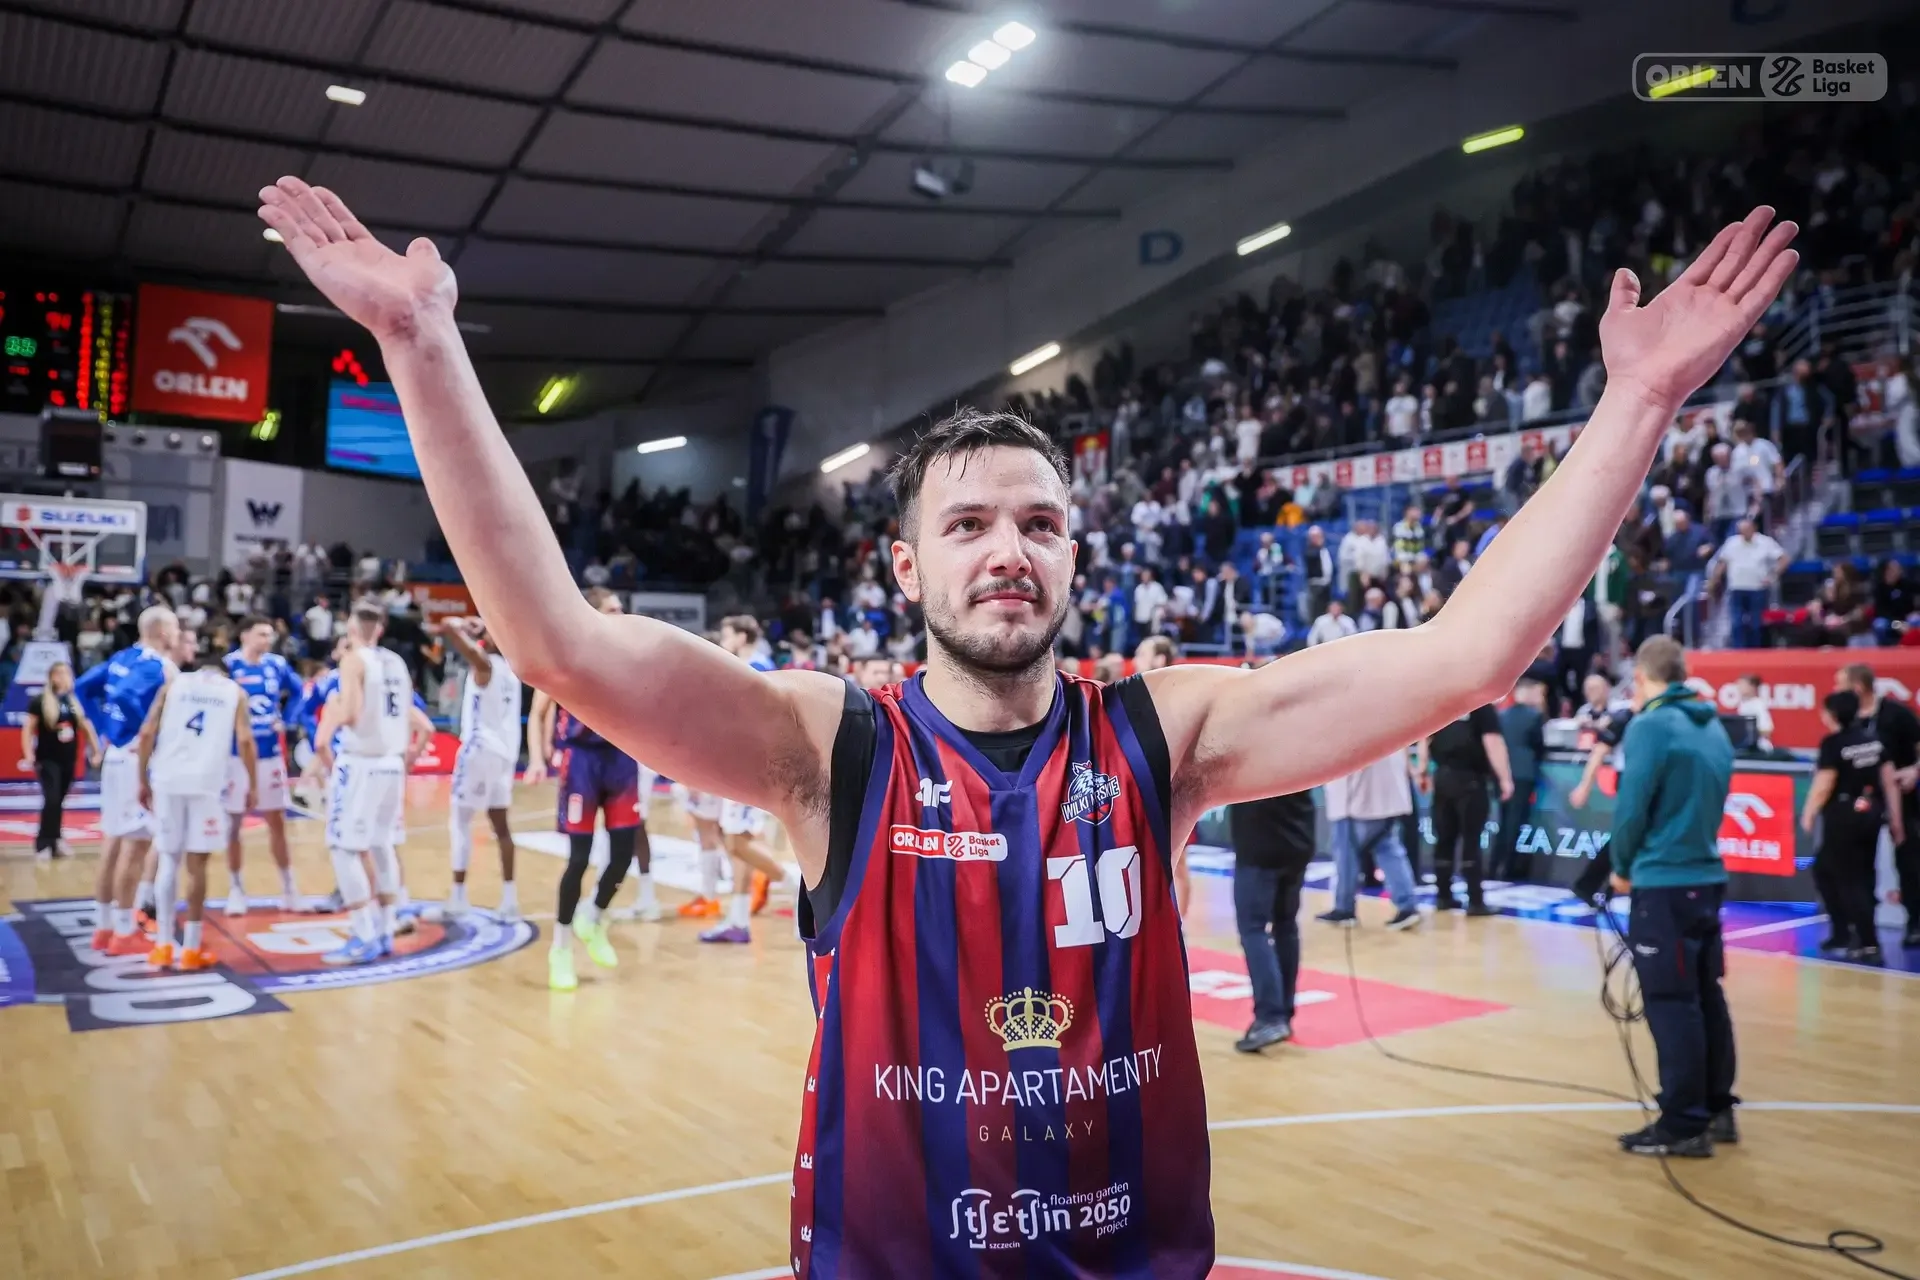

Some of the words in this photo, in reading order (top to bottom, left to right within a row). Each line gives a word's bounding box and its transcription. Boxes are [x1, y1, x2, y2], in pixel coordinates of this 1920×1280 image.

[154, 370, 248, 402] ORLEN
[41, 511, 127, 526] SUZUKI
[1718, 682, 1816, 710] OLEN
[185, 709, 206, 737] 4
[1063, 795, 1089, 820] WILKI
[1090, 778, 1119, 807] RSKIE
[893, 832, 939, 851] ORLEN
[968, 835, 1001, 847] Basket
[969, 846, 989, 857] Liga
[1516, 824, 1553, 856] ZA
[1716, 837, 1781, 860] RLEN
[1046, 845, 1142, 949] 10
[875, 1063, 945, 1104] KING
[955, 1043, 1162, 1107] APARTAMENTY
[979, 1119, 1094, 1142] GALAXY
[1050, 1192, 1093, 1206] floating
[1096, 1181, 1129, 1201] garden
[1079, 1194, 1131, 1228] 2050
[1096, 1217, 1128, 1239] project
[989, 1240, 1021, 1249] szczecin
